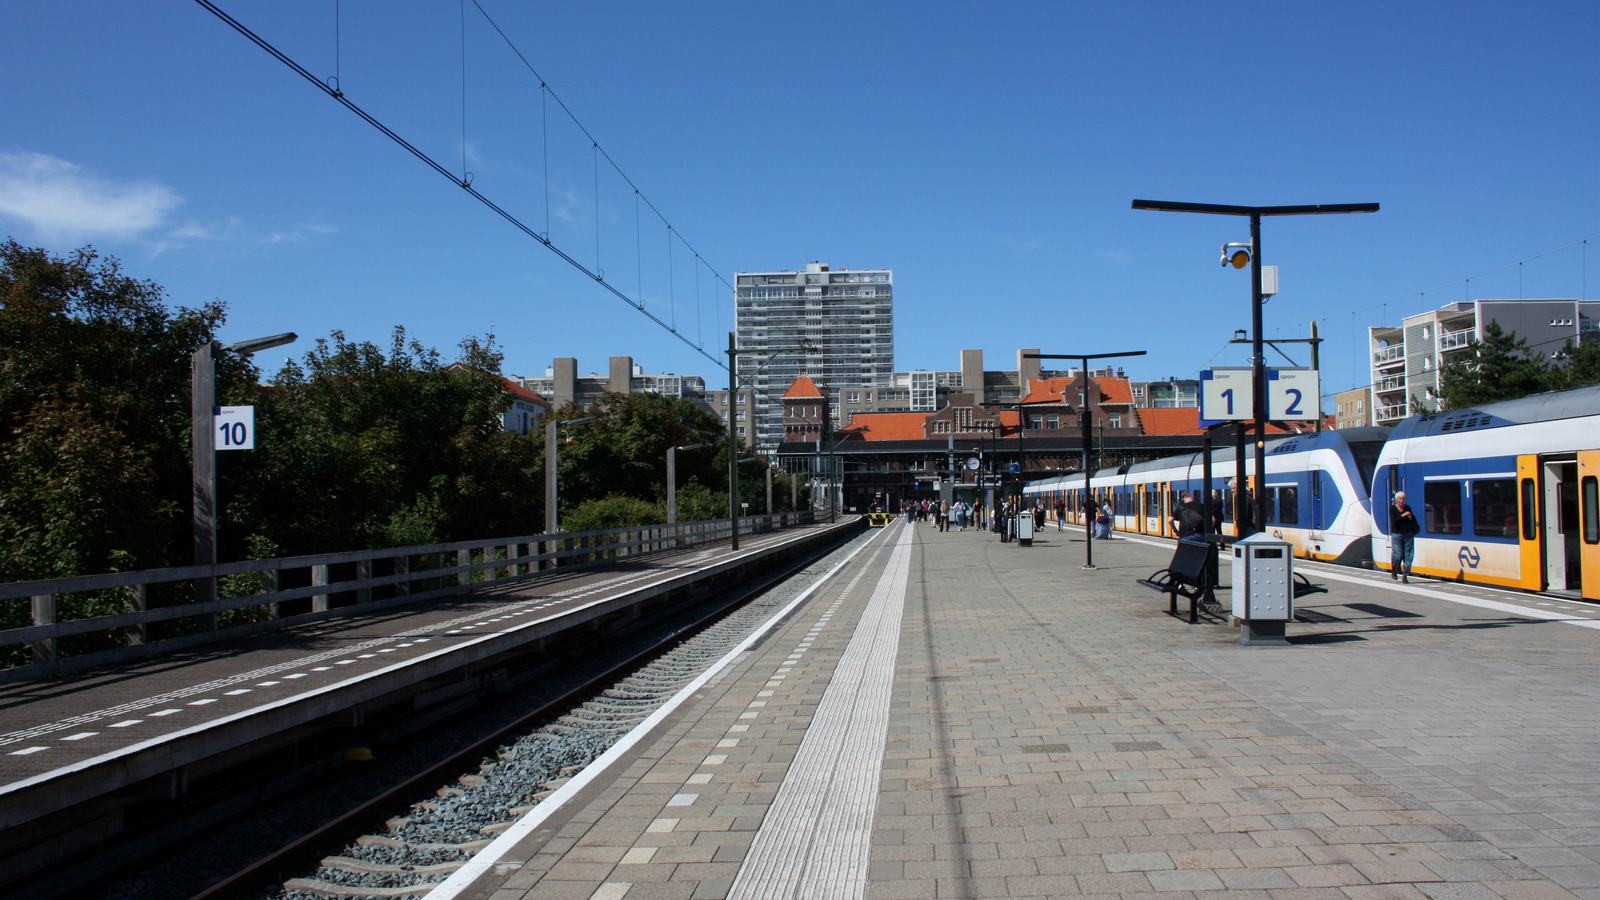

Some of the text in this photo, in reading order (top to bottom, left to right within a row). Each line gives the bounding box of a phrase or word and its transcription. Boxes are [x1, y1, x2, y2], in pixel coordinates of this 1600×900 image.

[1220, 388, 1233, 415] 1
[1285, 388, 1303, 415] 2
[219, 422, 247, 446] 10
[1464, 480, 1470, 498] 1
